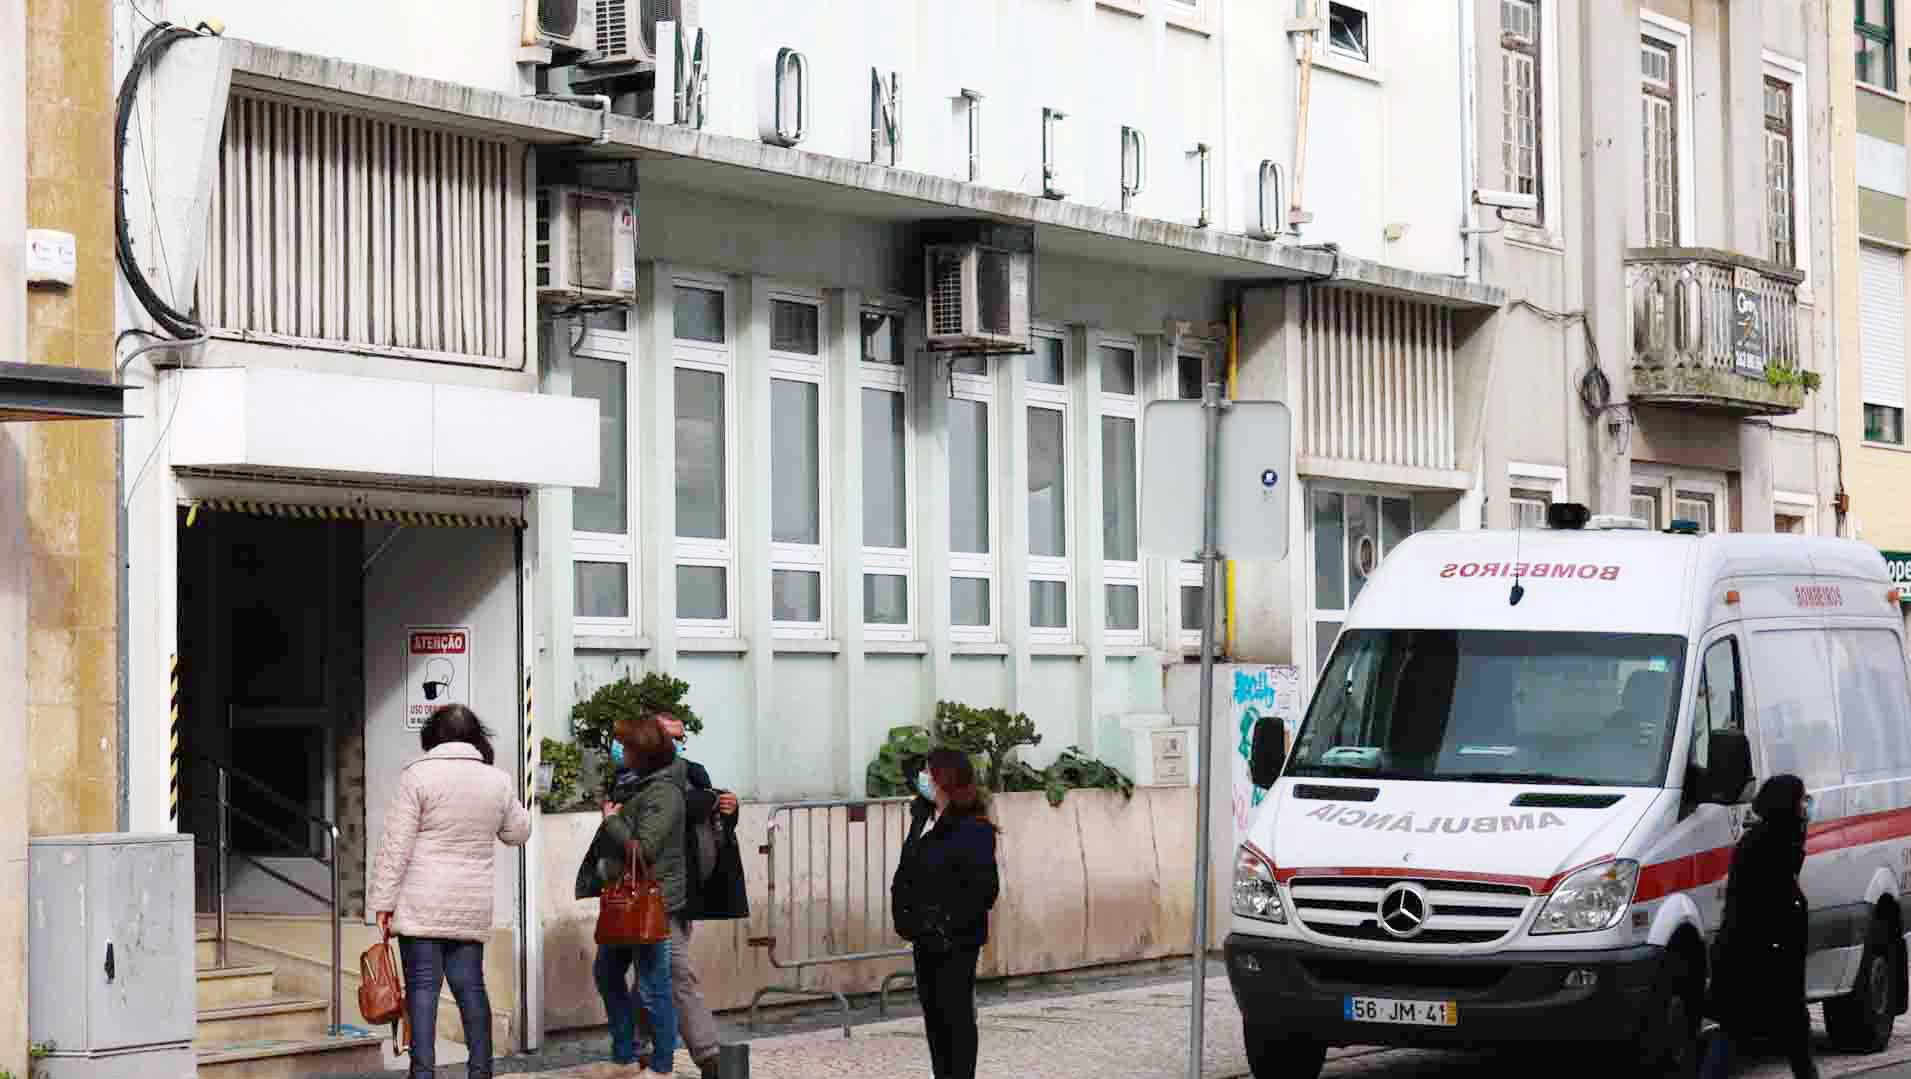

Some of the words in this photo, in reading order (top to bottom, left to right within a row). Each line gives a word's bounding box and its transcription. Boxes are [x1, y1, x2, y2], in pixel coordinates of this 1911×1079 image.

[655, 16, 1288, 241] MONTEPIO
[413, 634, 464, 653] ATENÇÃO
[1354, 1000, 1376, 1019] 56
[1389, 1002, 1416, 1021] JM
[1425, 1005, 1446, 1025] 41
